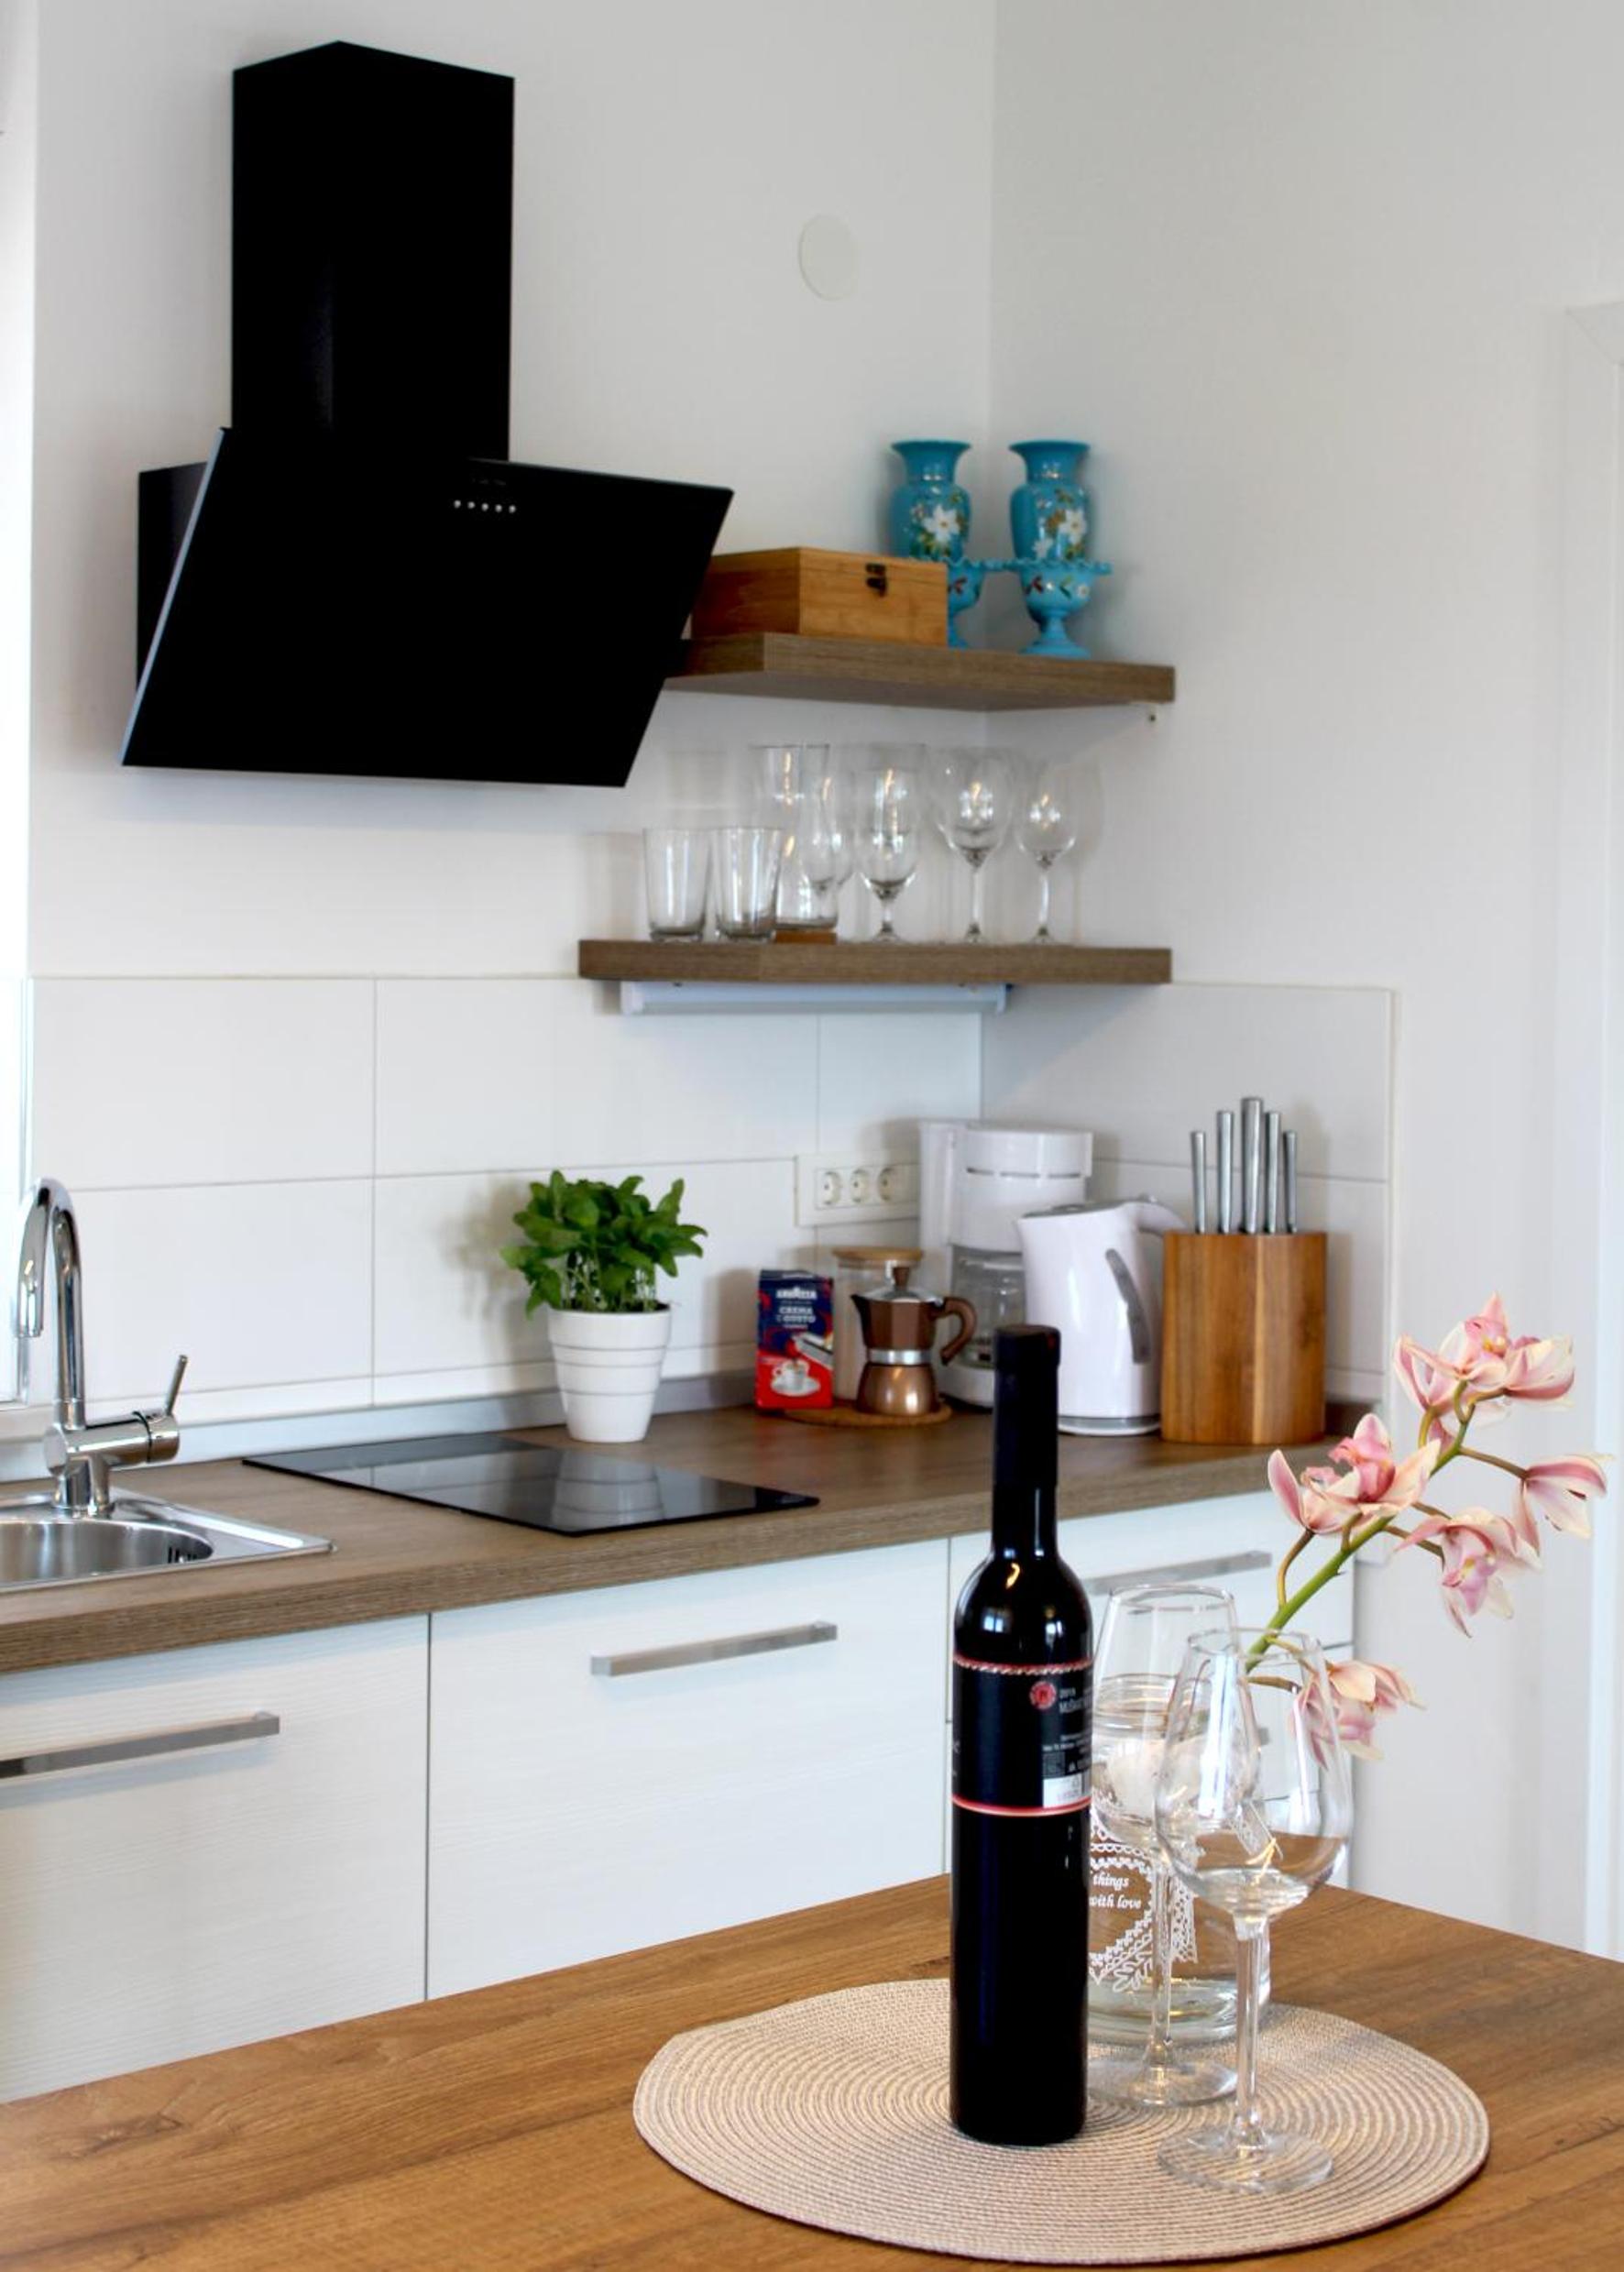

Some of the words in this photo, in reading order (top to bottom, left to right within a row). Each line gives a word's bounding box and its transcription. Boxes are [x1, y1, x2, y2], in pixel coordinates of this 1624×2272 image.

[779, 1306, 814, 1315] CREMA
[783, 1314, 817, 1323] GUSTO
[1093, 1871, 1129, 1891] things
[1116, 1894, 1142, 1909] love
